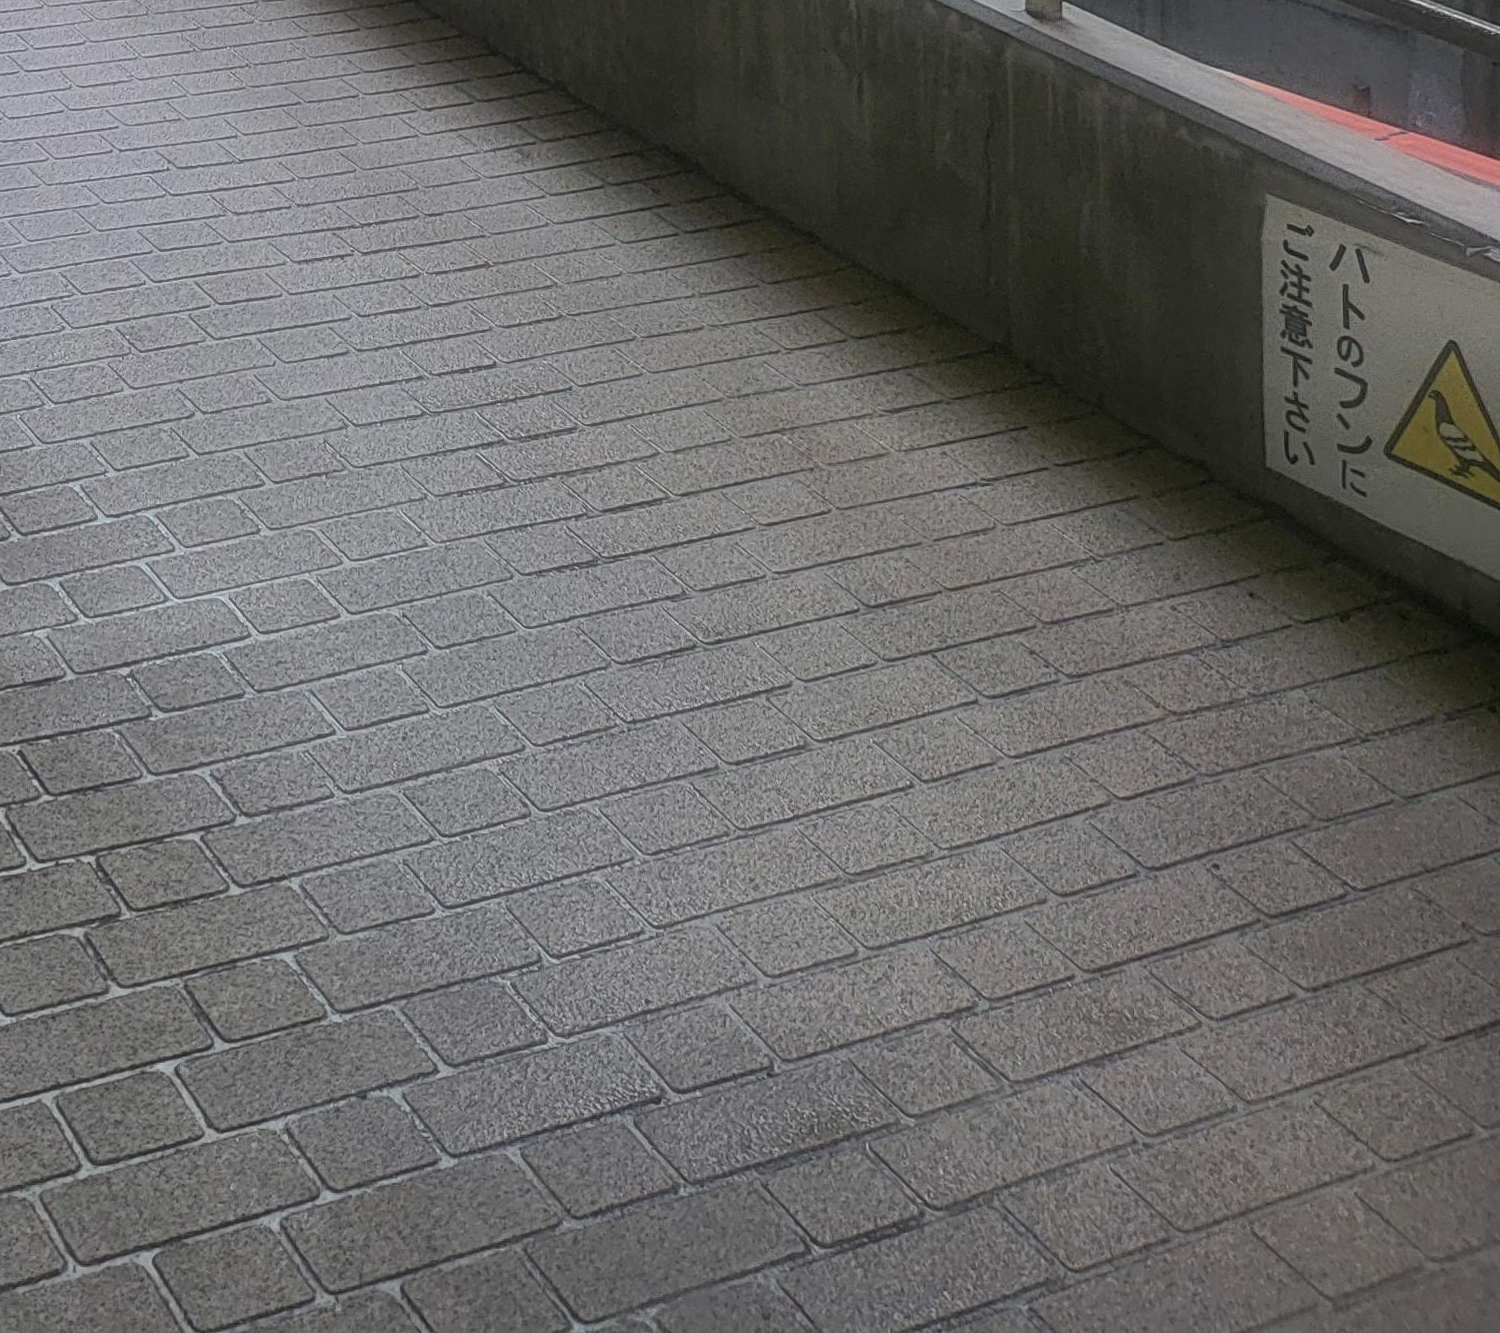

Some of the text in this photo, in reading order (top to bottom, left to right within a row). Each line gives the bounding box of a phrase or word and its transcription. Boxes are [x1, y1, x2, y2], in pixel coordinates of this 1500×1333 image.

[1279, 223, 1316, 467] ご注意下さい
[1328, 242, 1373, 500] ハトのフンに
